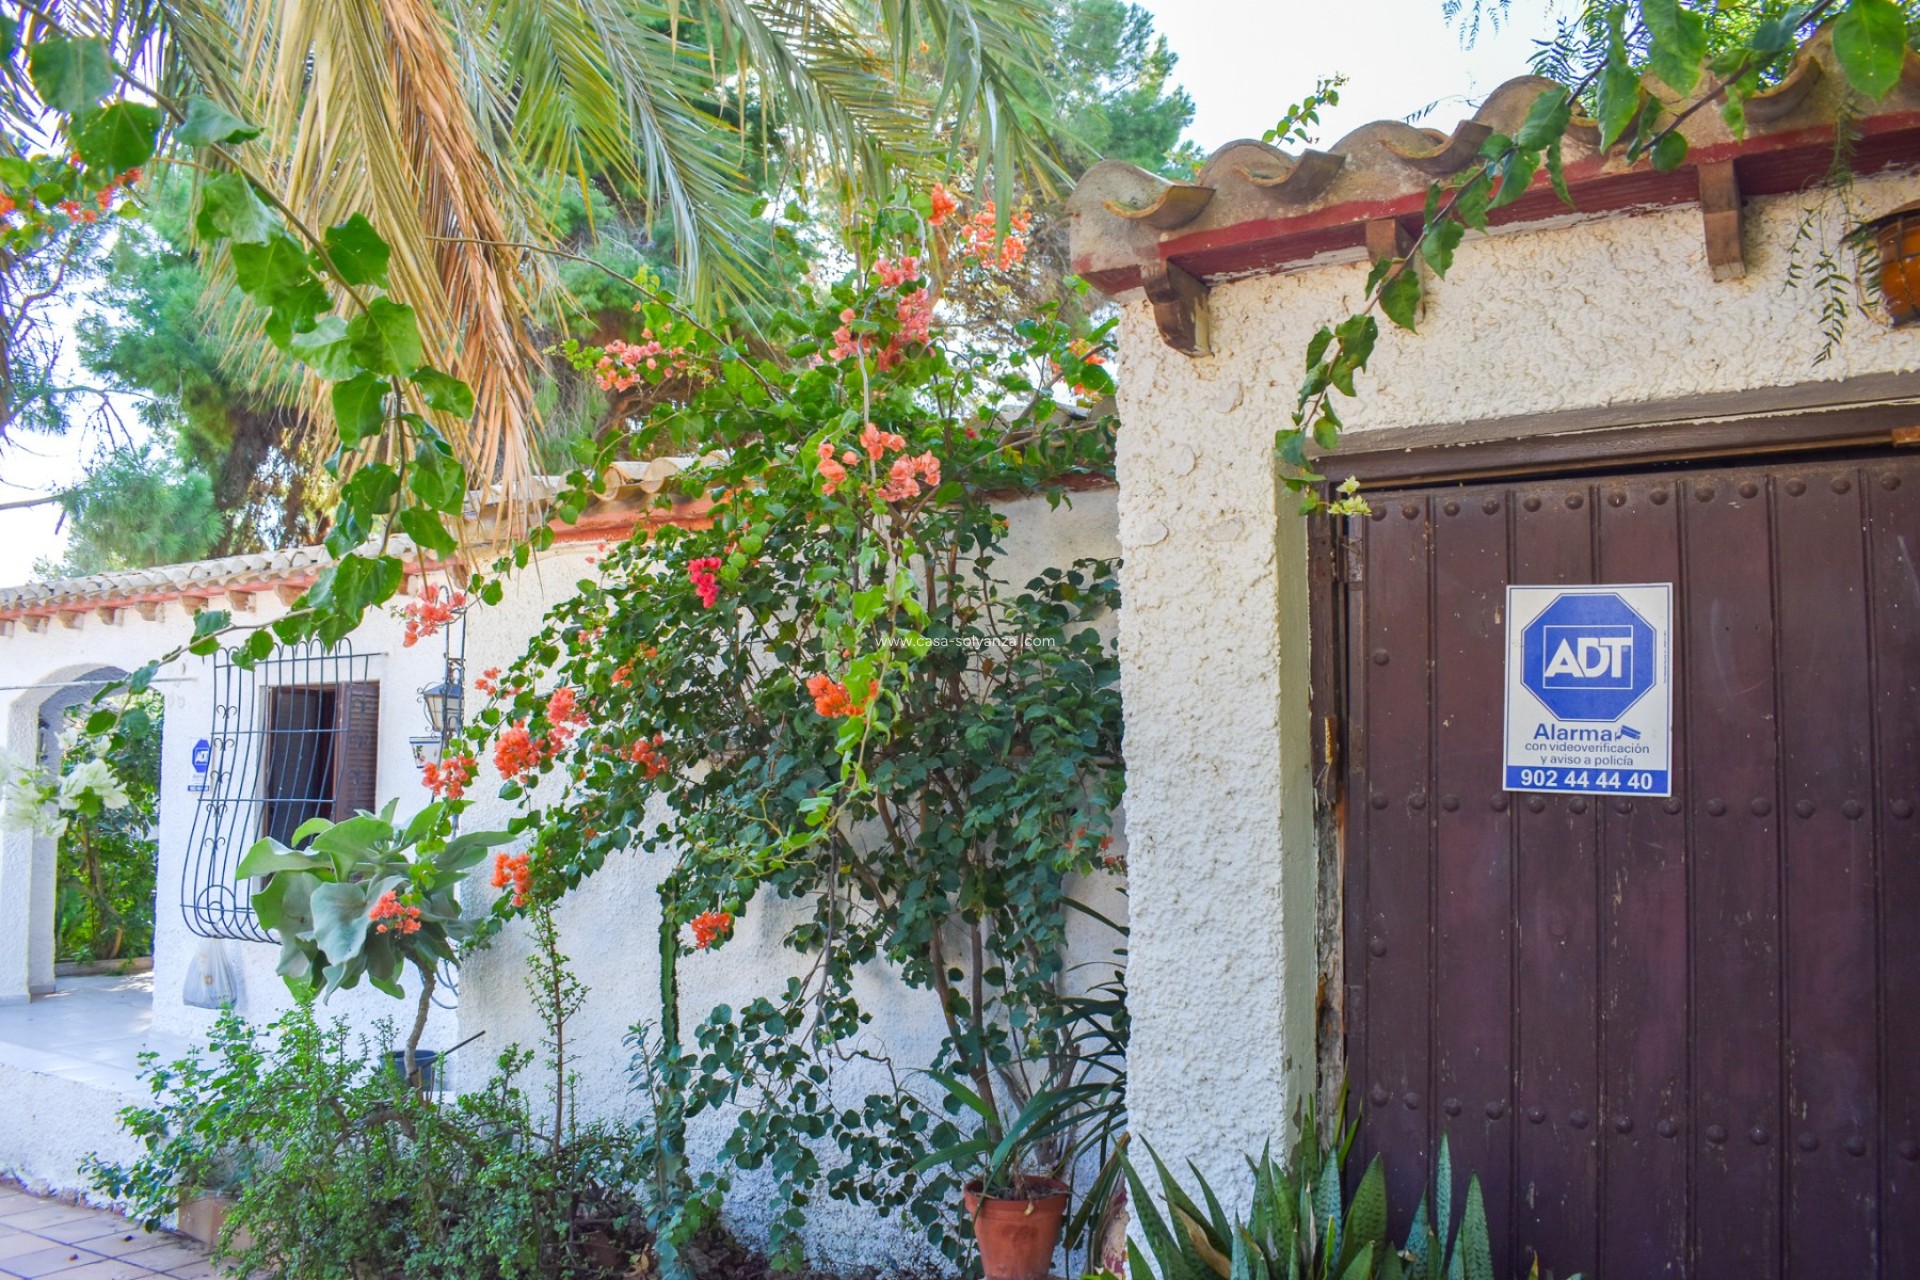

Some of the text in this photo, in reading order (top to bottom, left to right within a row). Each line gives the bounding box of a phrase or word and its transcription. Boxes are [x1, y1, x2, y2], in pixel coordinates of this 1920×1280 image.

[1544, 637, 1632, 678] ADT
[1533, 723, 1612, 742] Alarma
[1525, 741, 1650, 754] con videoverificación
[1540, 754, 1634, 768] y aviso a policía
[1521, 769, 1653, 790] 902 44 44 40
